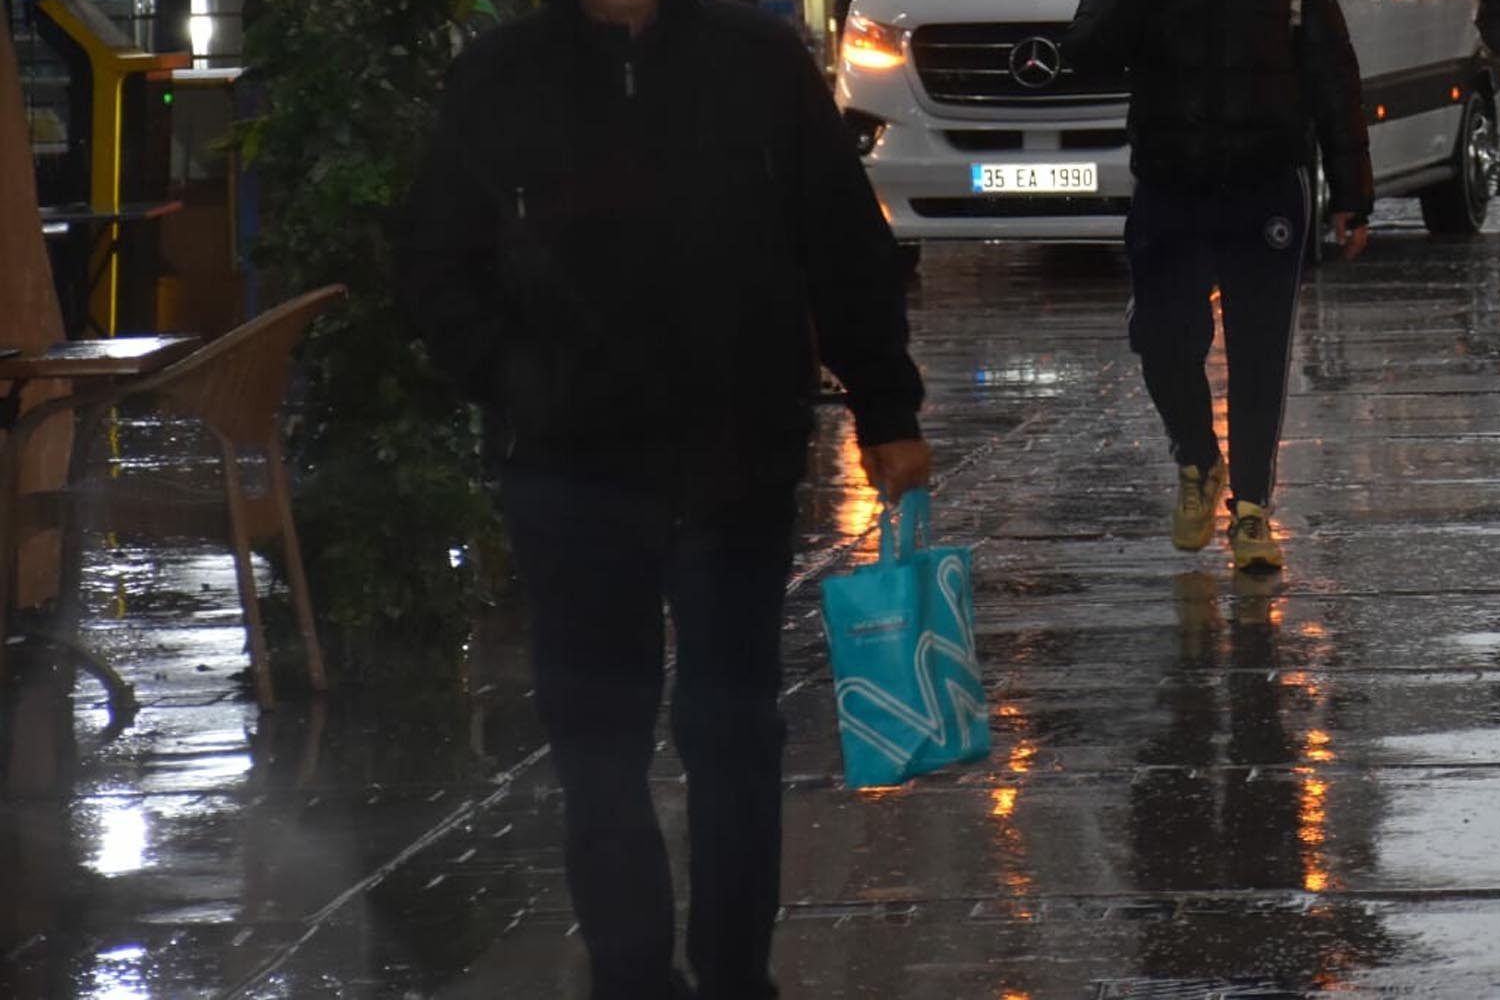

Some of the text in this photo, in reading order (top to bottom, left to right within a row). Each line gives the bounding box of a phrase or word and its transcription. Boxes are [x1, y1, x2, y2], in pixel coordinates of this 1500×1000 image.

[983, 168, 1005, 188] 35
[1016, 168, 1037, 188] EA
[1050, 168, 1093, 188] 1990
